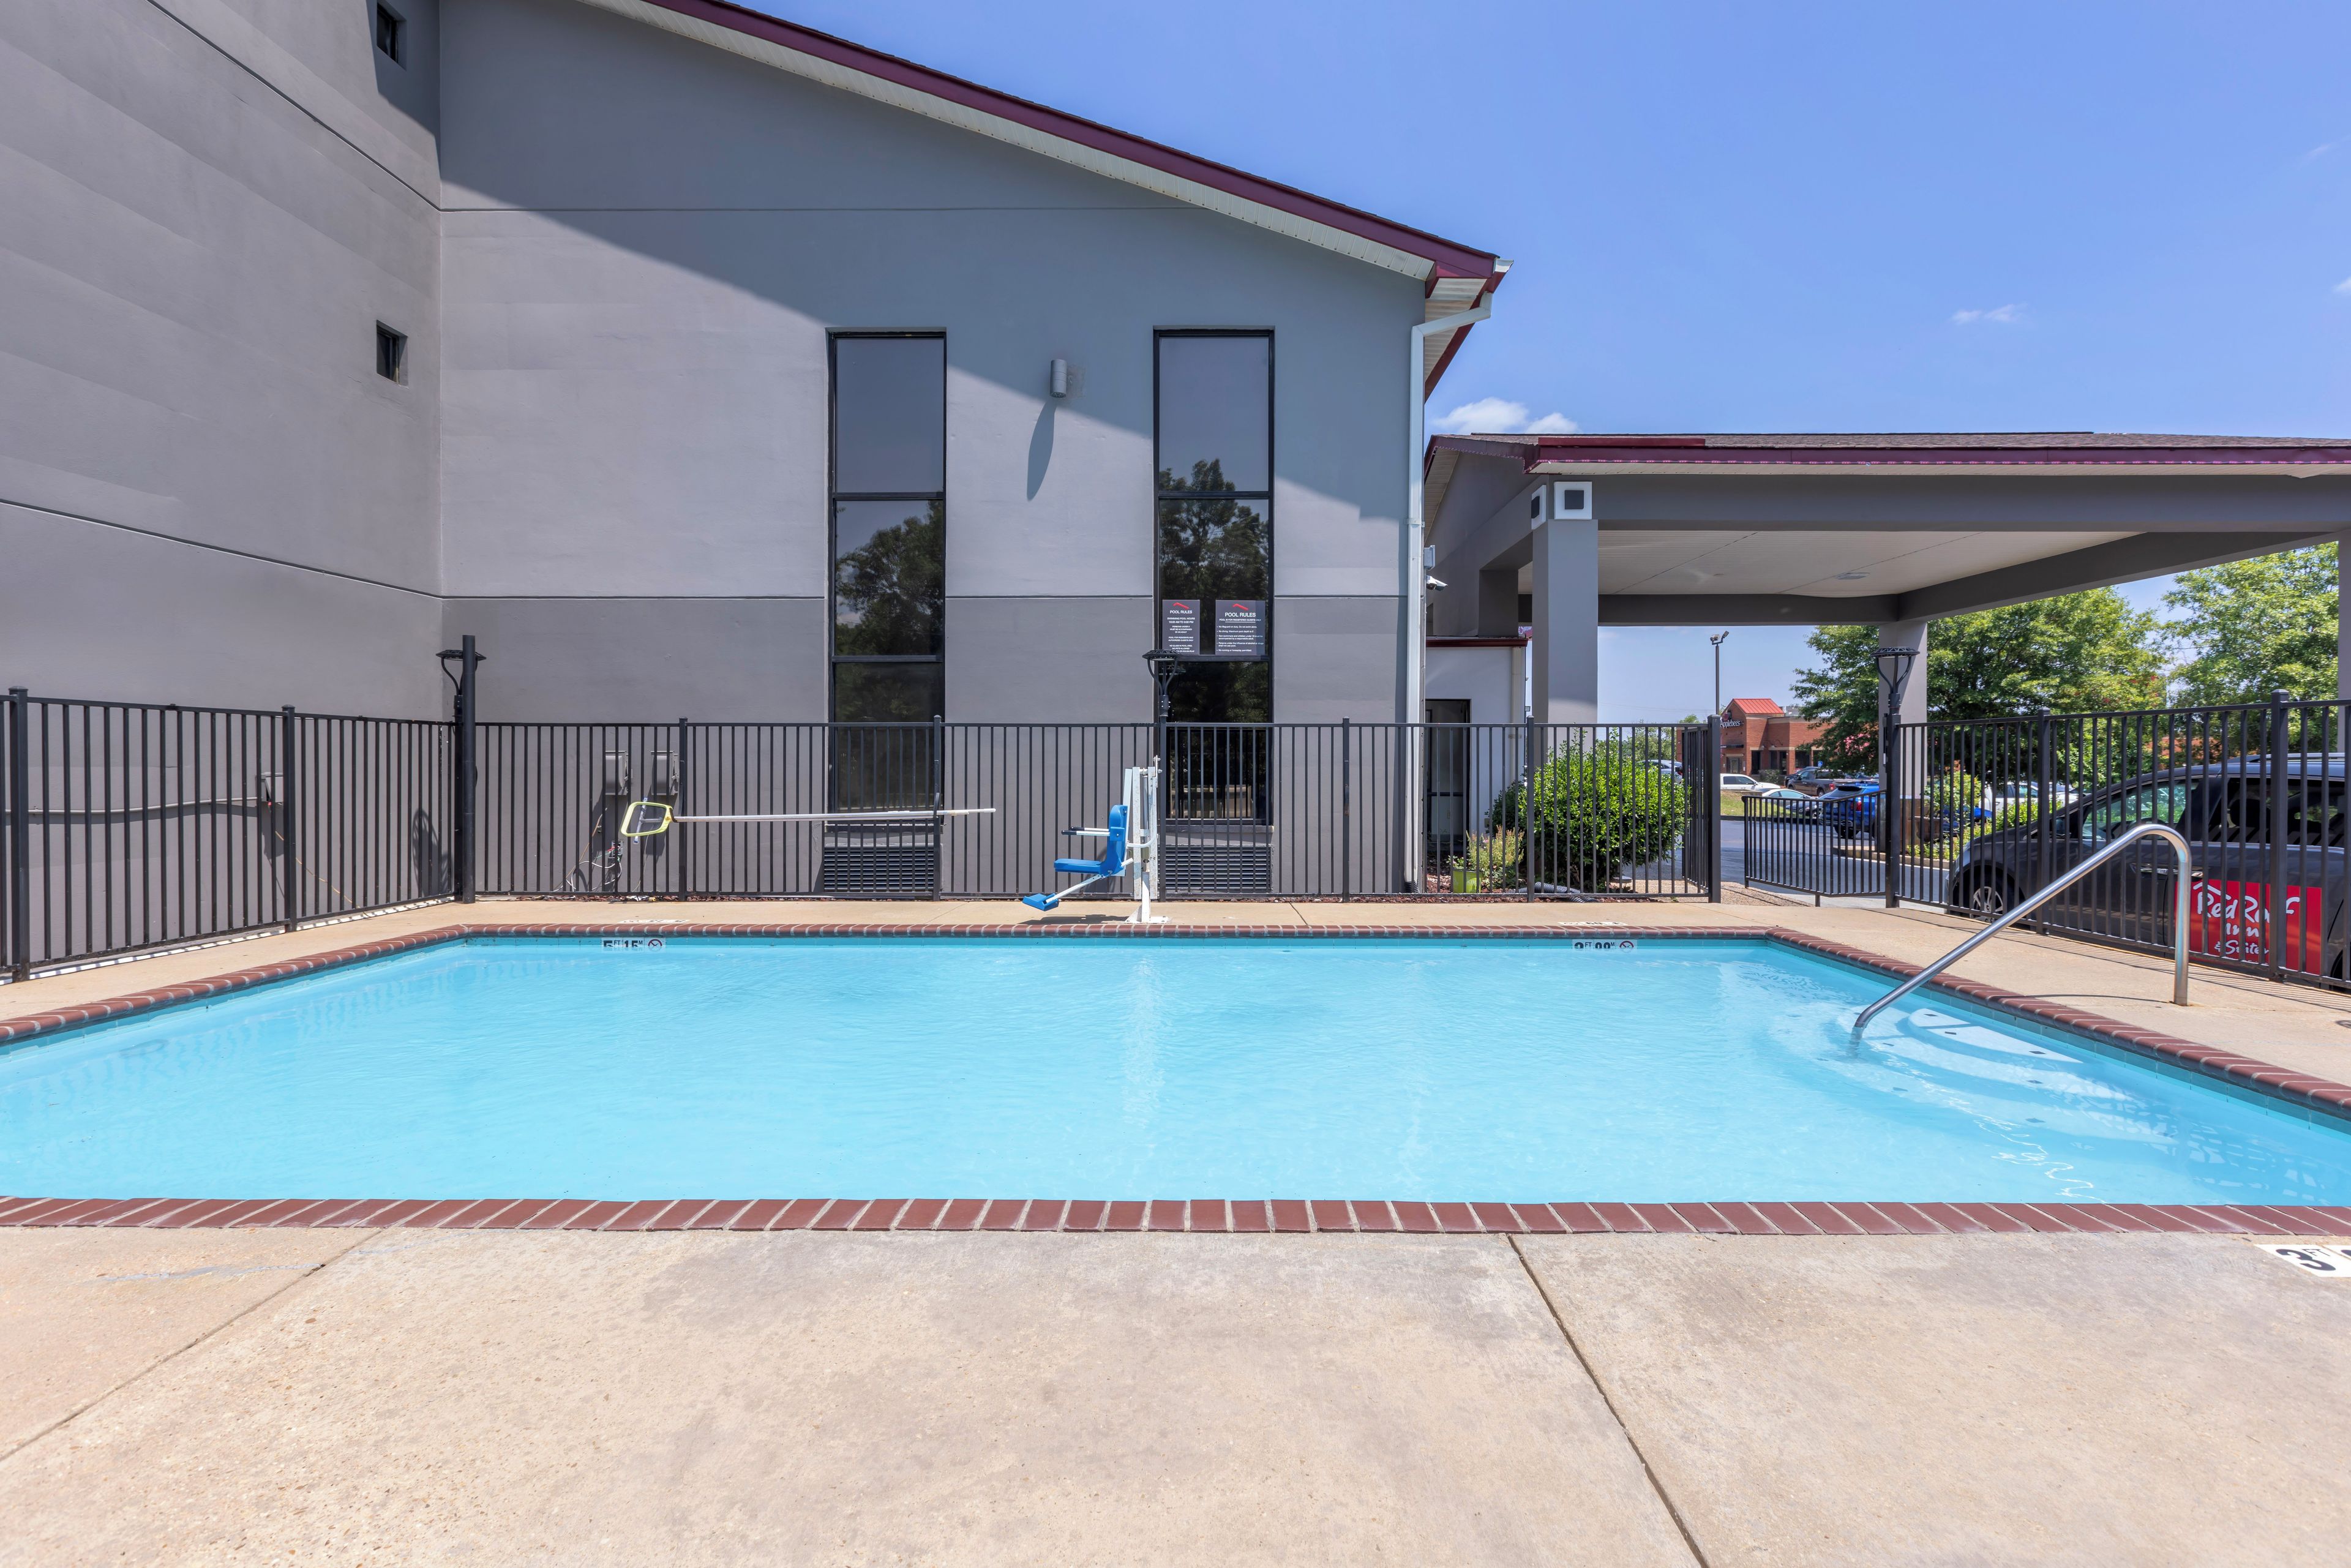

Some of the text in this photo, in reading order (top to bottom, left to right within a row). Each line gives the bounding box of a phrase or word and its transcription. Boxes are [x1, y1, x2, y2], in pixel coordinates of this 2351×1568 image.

[2197, 891, 2238, 919] Red
[2226, 923, 2260, 937] Inn
[2276, 1248, 2336, 1271] 3
